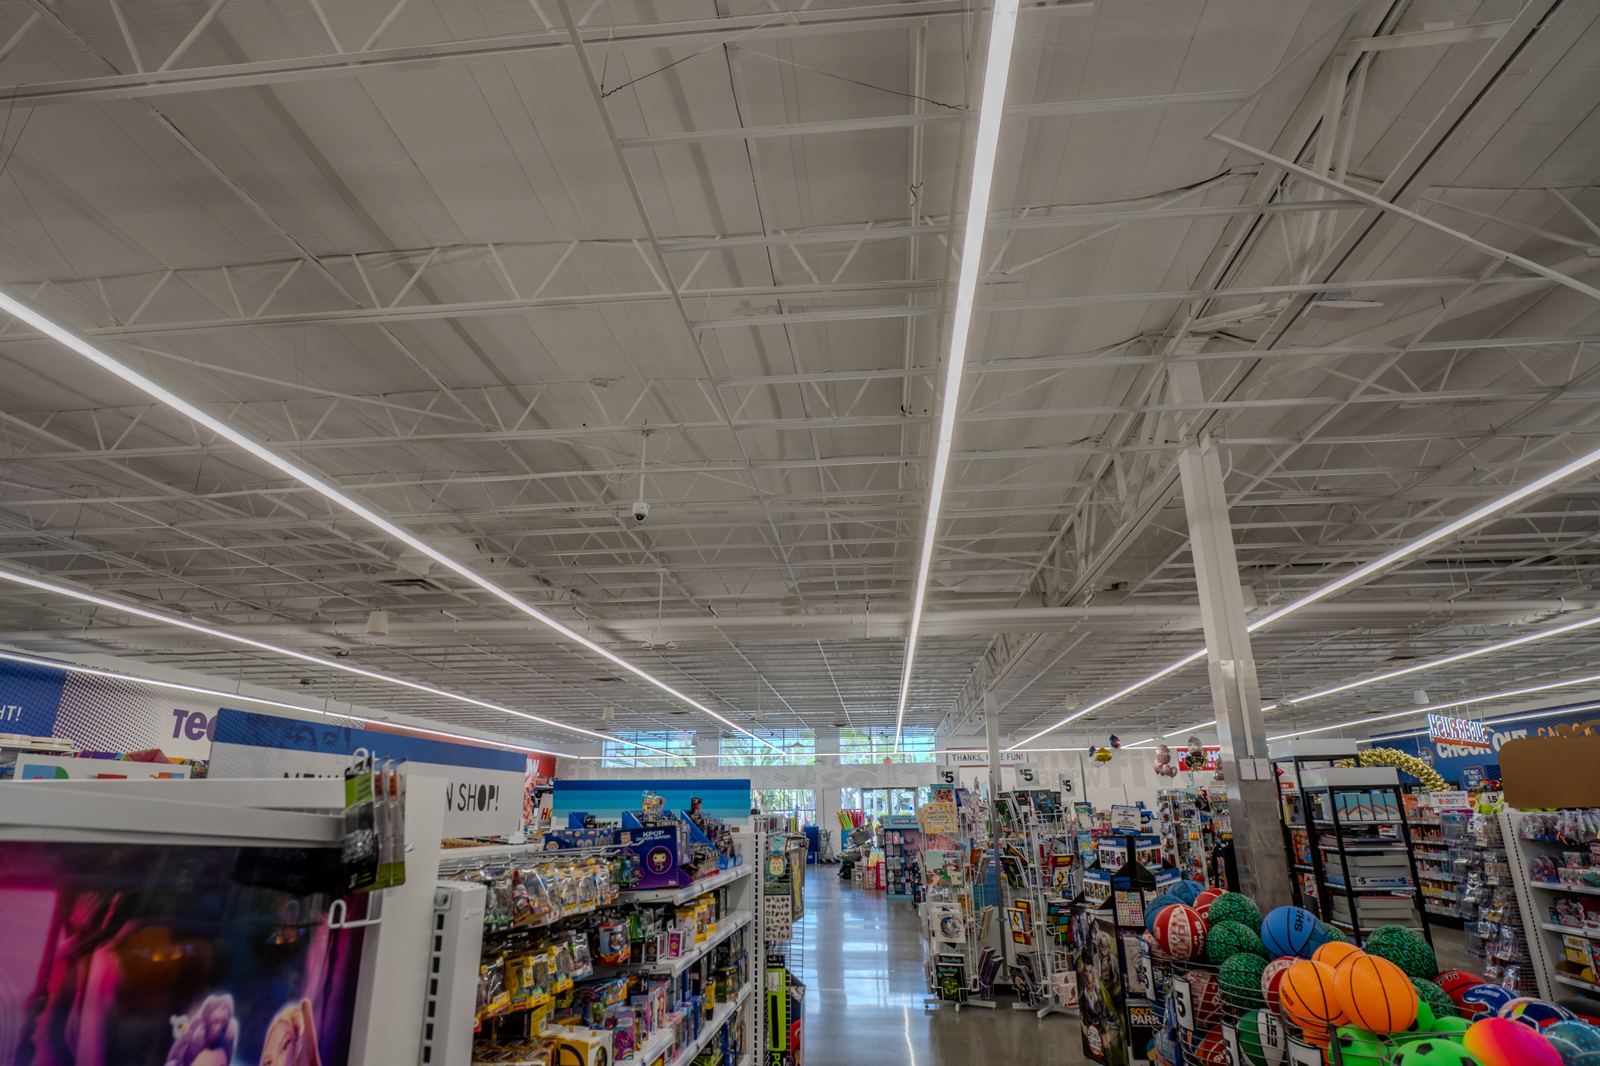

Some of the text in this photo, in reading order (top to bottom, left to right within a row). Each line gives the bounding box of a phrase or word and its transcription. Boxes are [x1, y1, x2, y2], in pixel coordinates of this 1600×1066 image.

[952, 754, 984, 762] THANKS,
[1006, 753, 1023, 761] FUN!
[941, 771, 954, 783] $5
[1019, 769, 1033, 781] $5
[1062, 780, 1072, 792] $5
[457, 783, 499, 811] SHOP!
[1294, 910, 1305, 933] SHA
[1176, 991, 1186, 1017] 5
[1130, 1007, 1153, 1015] SOUT
